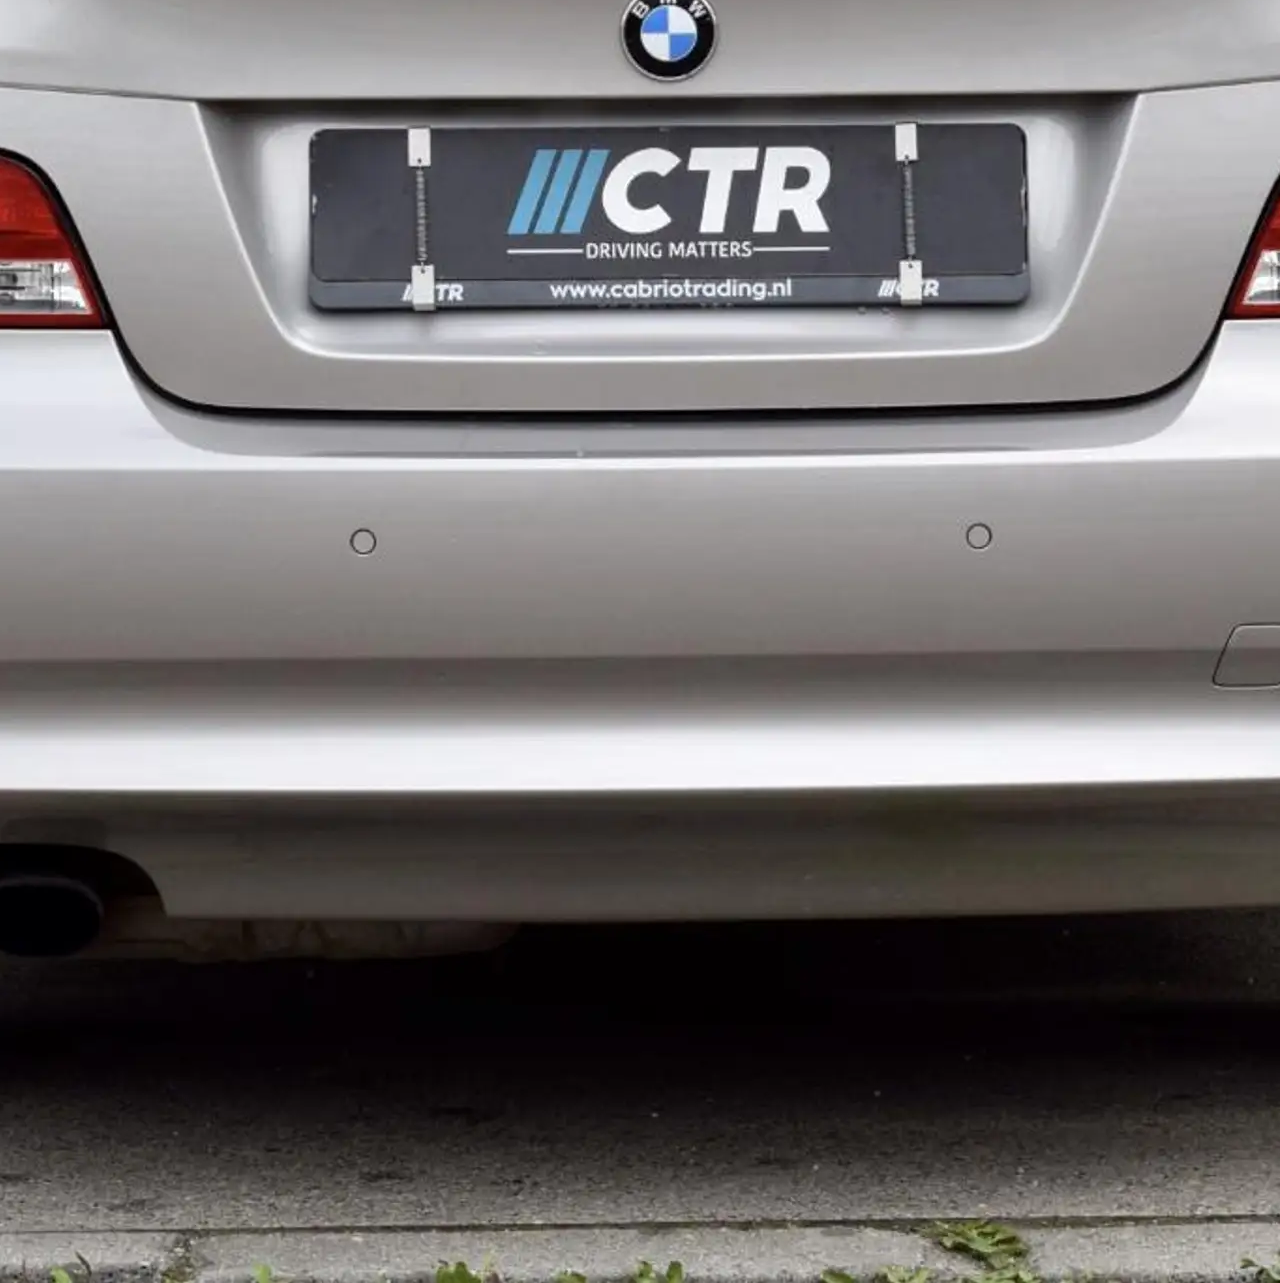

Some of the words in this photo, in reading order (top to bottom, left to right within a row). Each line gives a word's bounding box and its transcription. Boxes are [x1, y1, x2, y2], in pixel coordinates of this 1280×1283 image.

[601, 146, 831, 235] CTR
[585, 243, 663, 260] DRIVING
[668, 241, 754, 259] MATTERS
[549, 278, 793, 301] www.cabriotrading.nl
